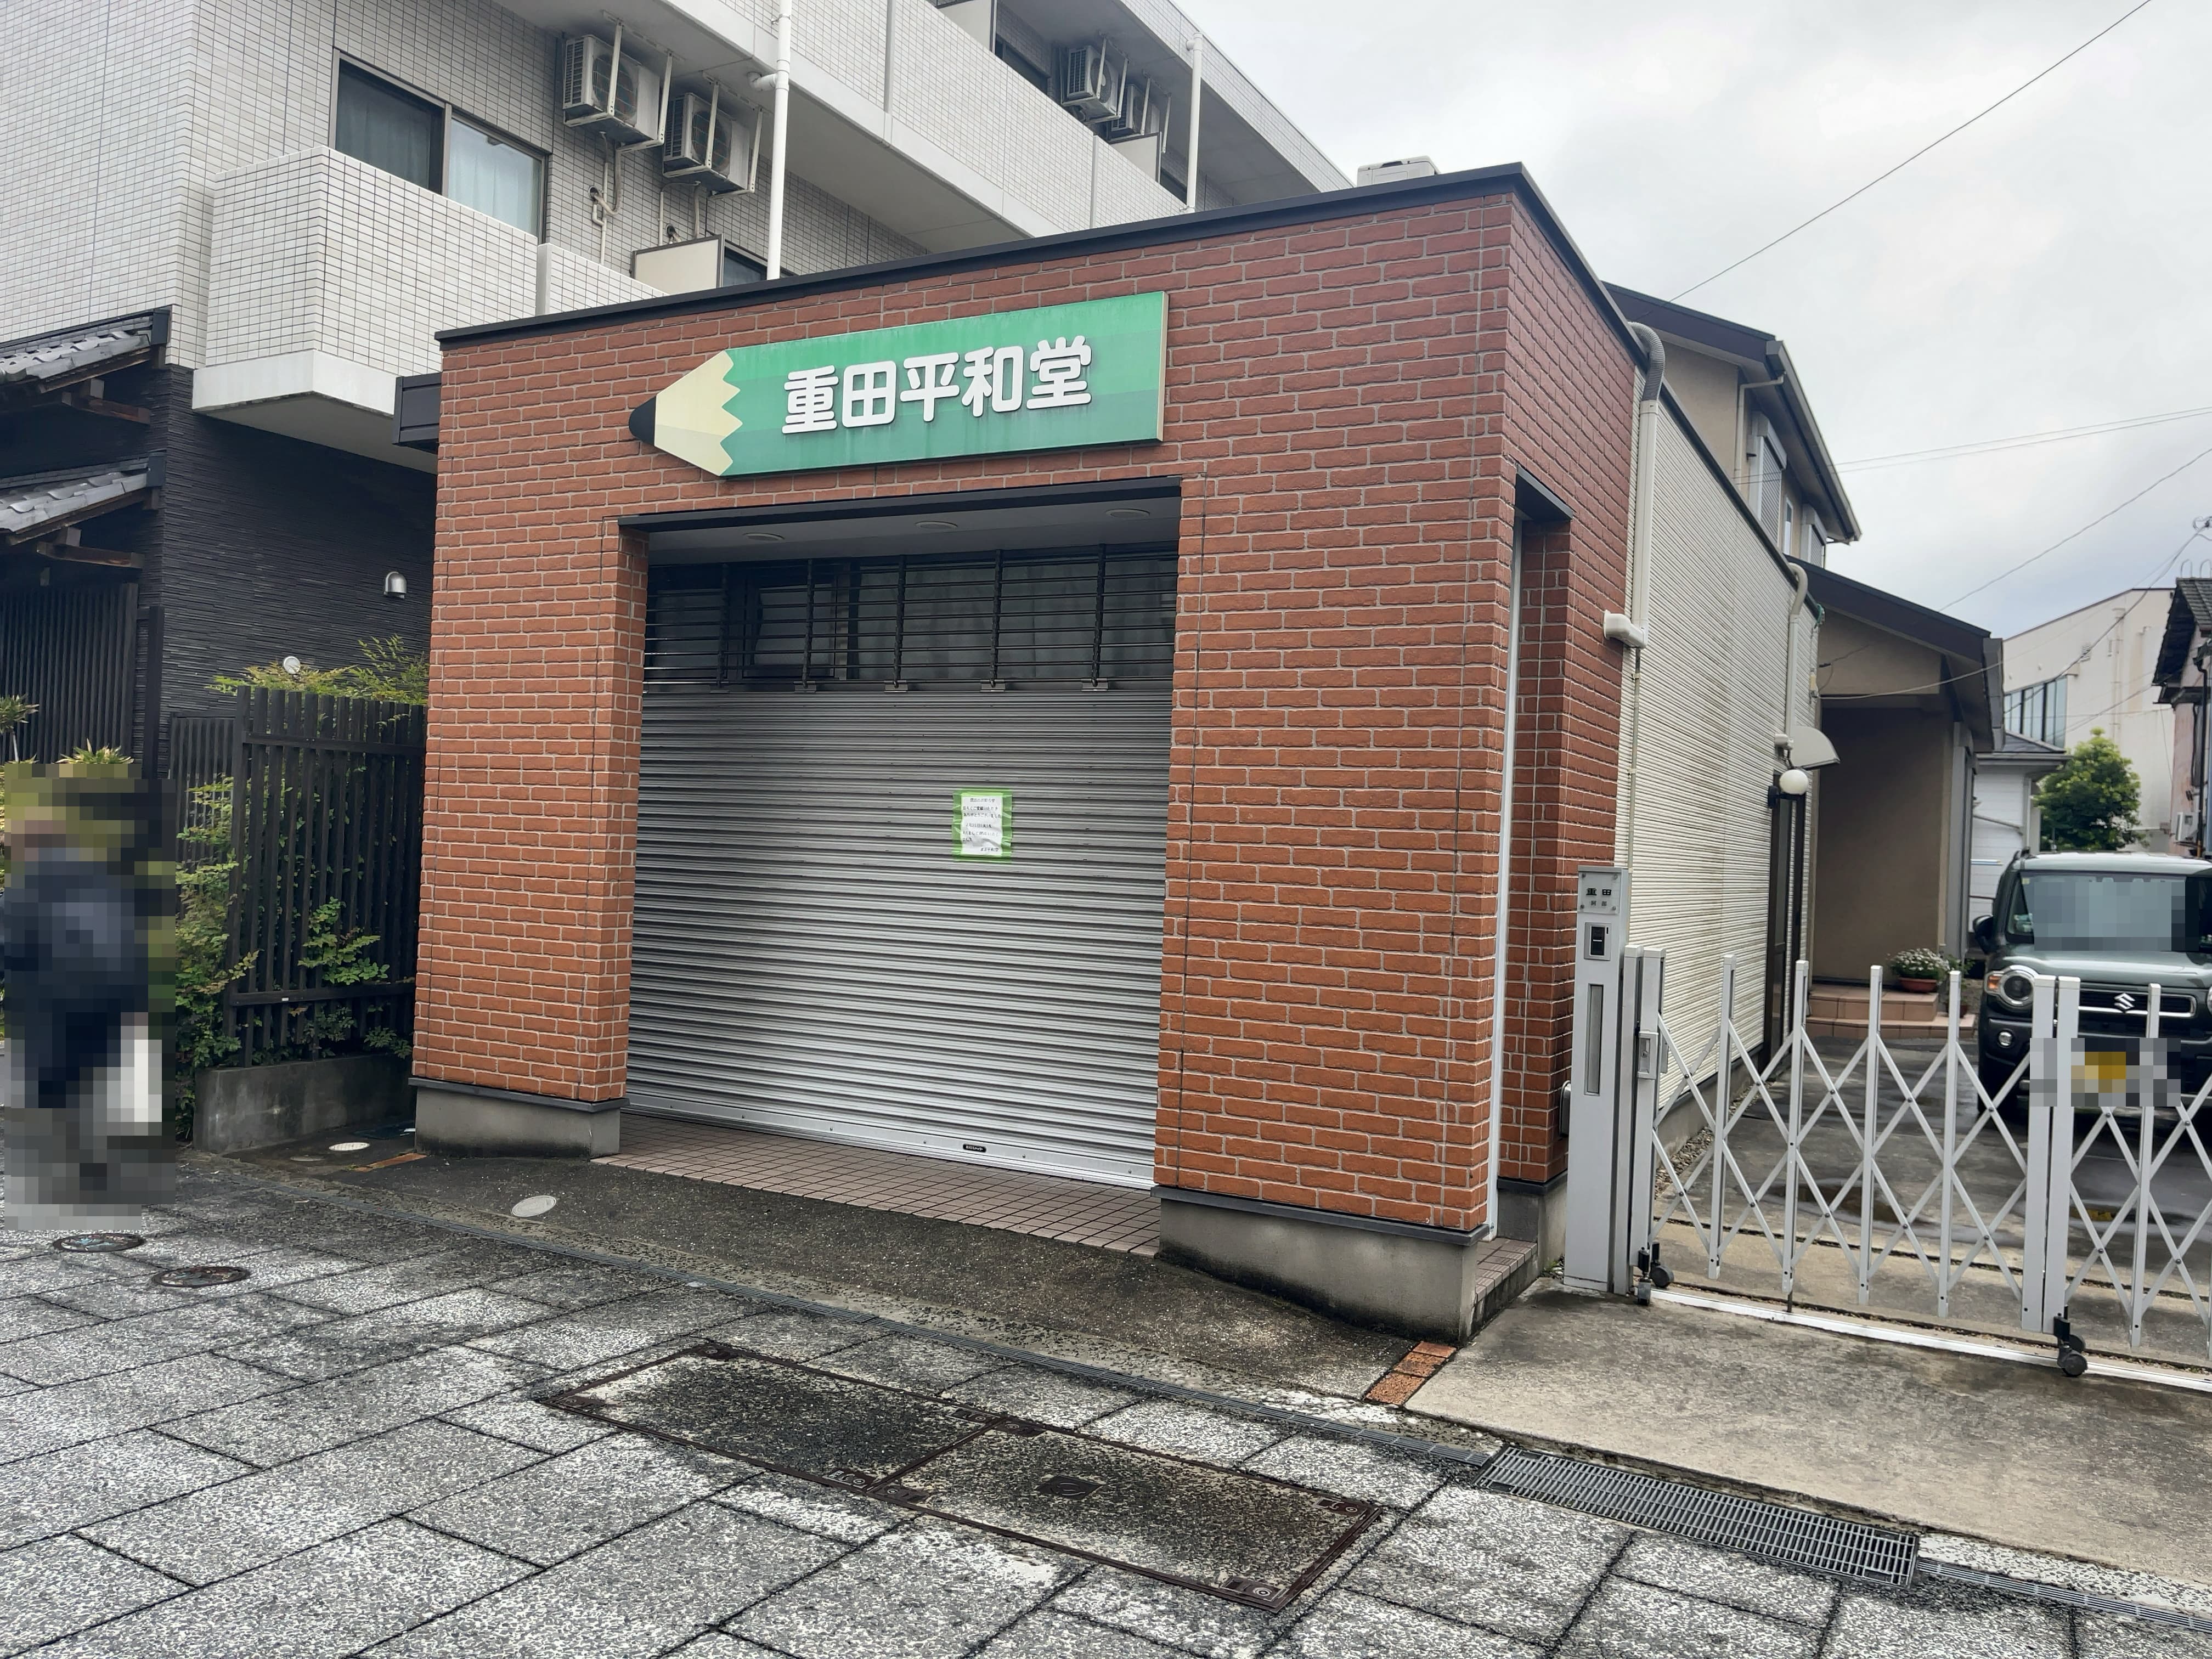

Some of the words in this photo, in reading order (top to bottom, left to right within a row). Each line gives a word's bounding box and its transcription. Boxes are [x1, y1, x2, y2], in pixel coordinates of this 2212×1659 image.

[782, 335, 1092, 434] 重田平和堂
[1585, 887, 1612, 896] 重田
